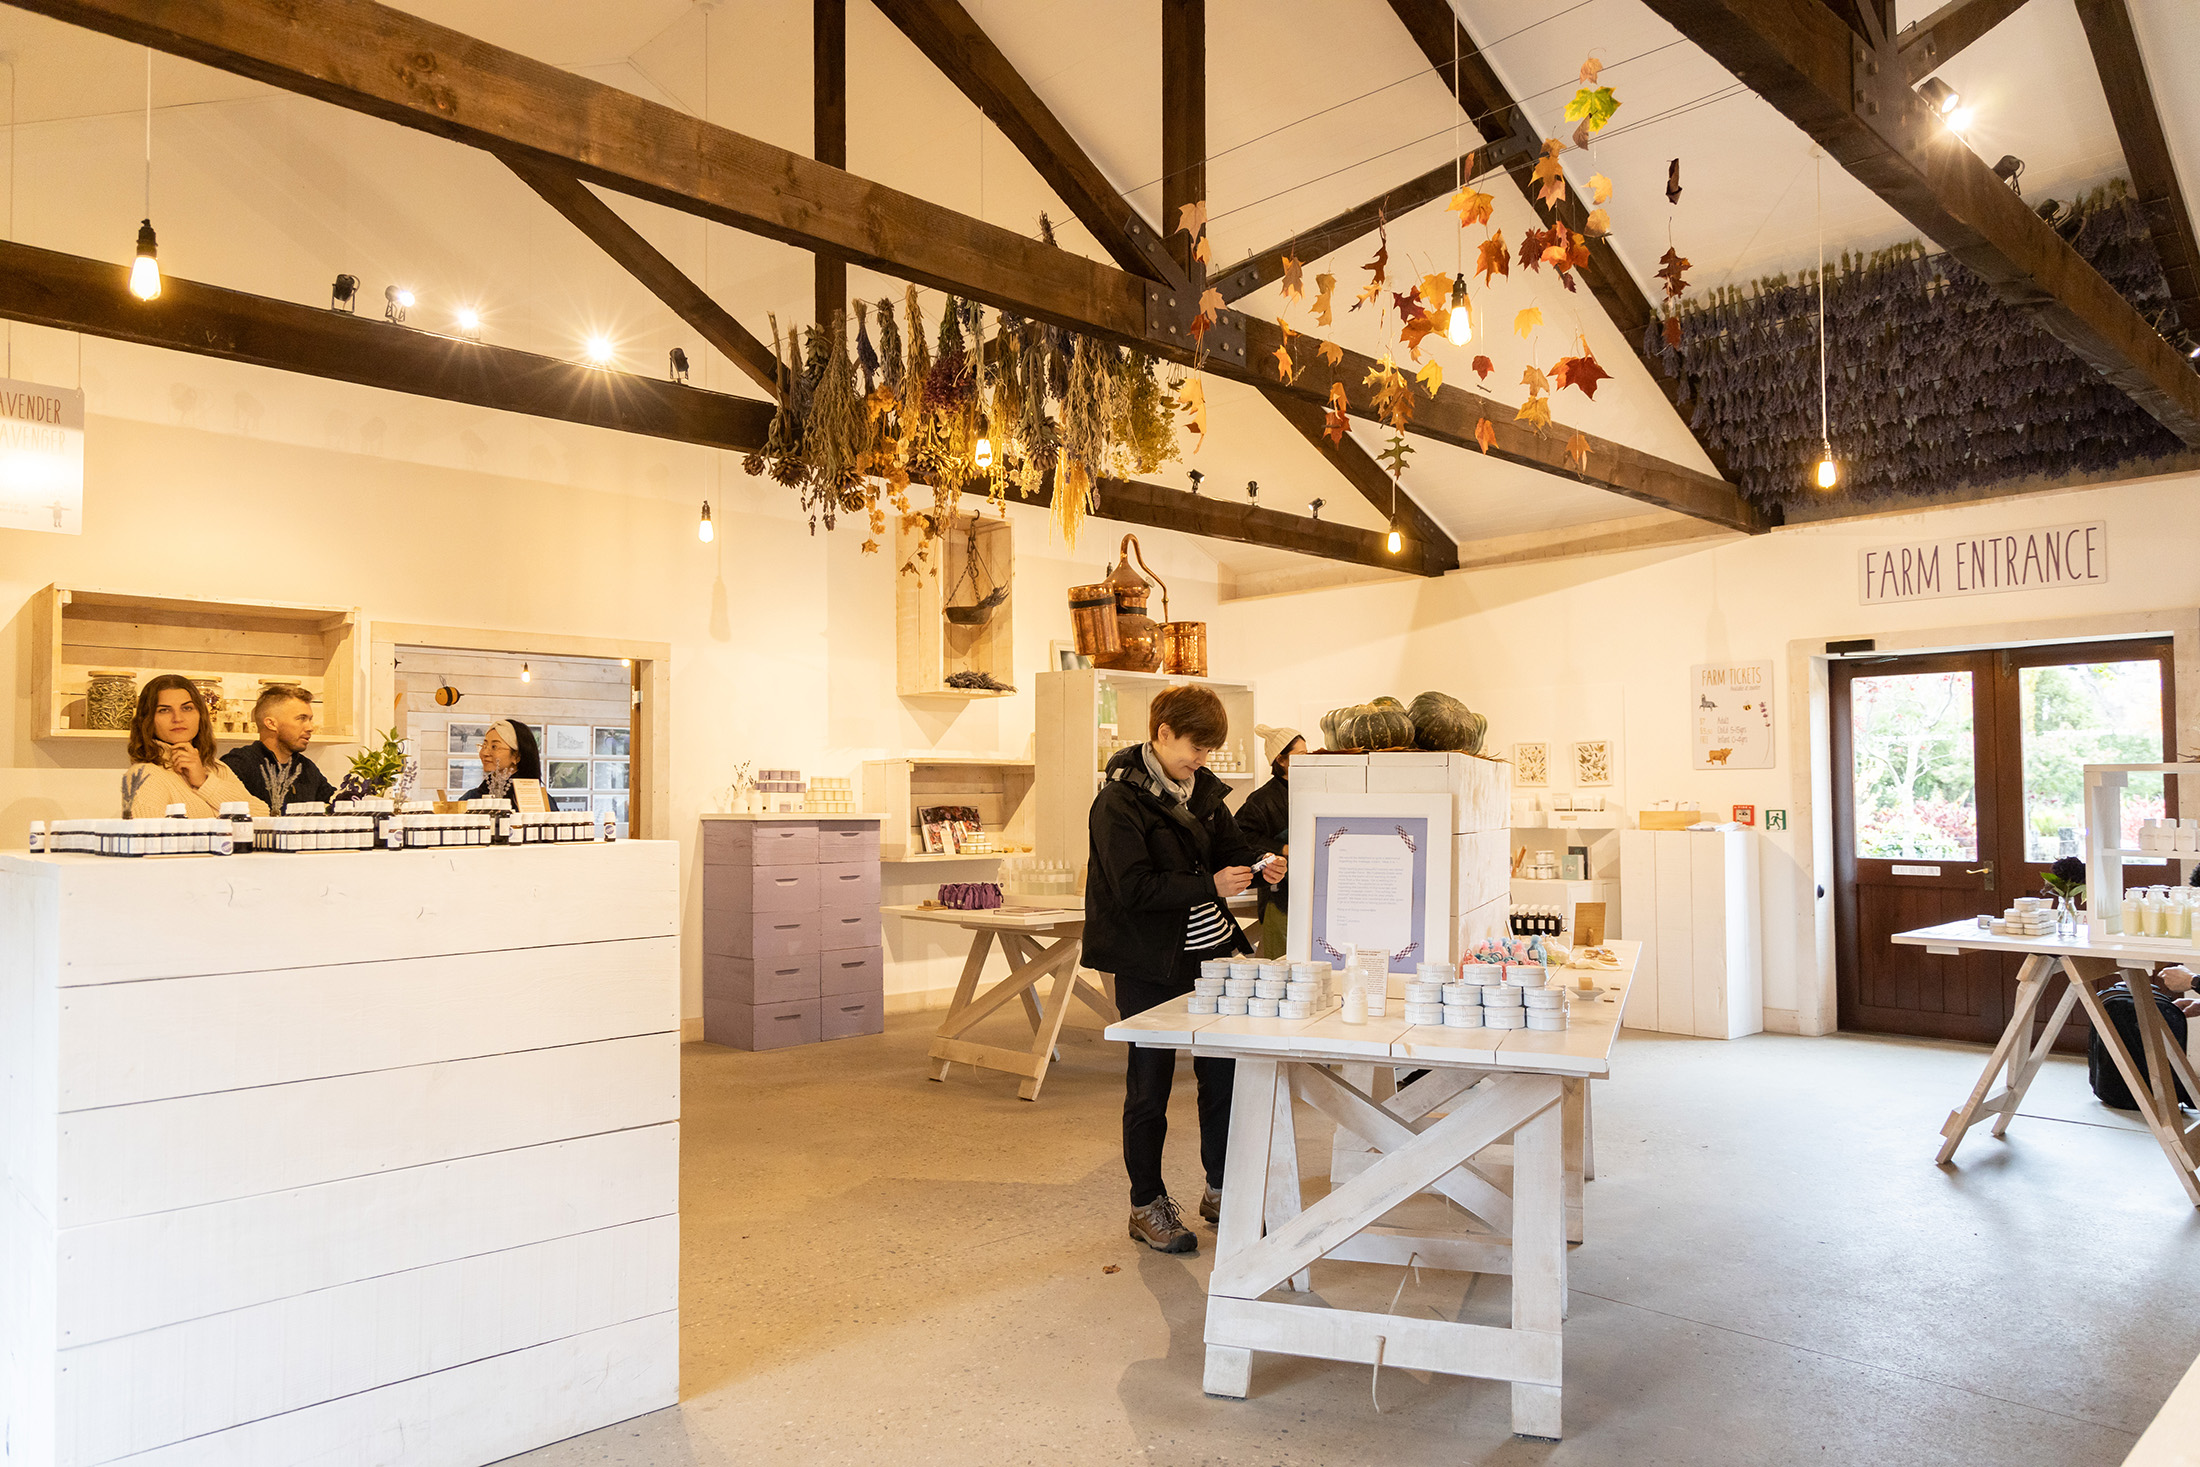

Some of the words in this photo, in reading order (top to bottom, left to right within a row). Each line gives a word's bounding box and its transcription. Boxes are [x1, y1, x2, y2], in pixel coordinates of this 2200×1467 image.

[1866, 545, 1941, 599] FARM
[1956, 527, 2099, 591] ENTRANCE
[1702, 669, 1726, 686] FARM
[1729, 667, 1762, 685] TICKETS
